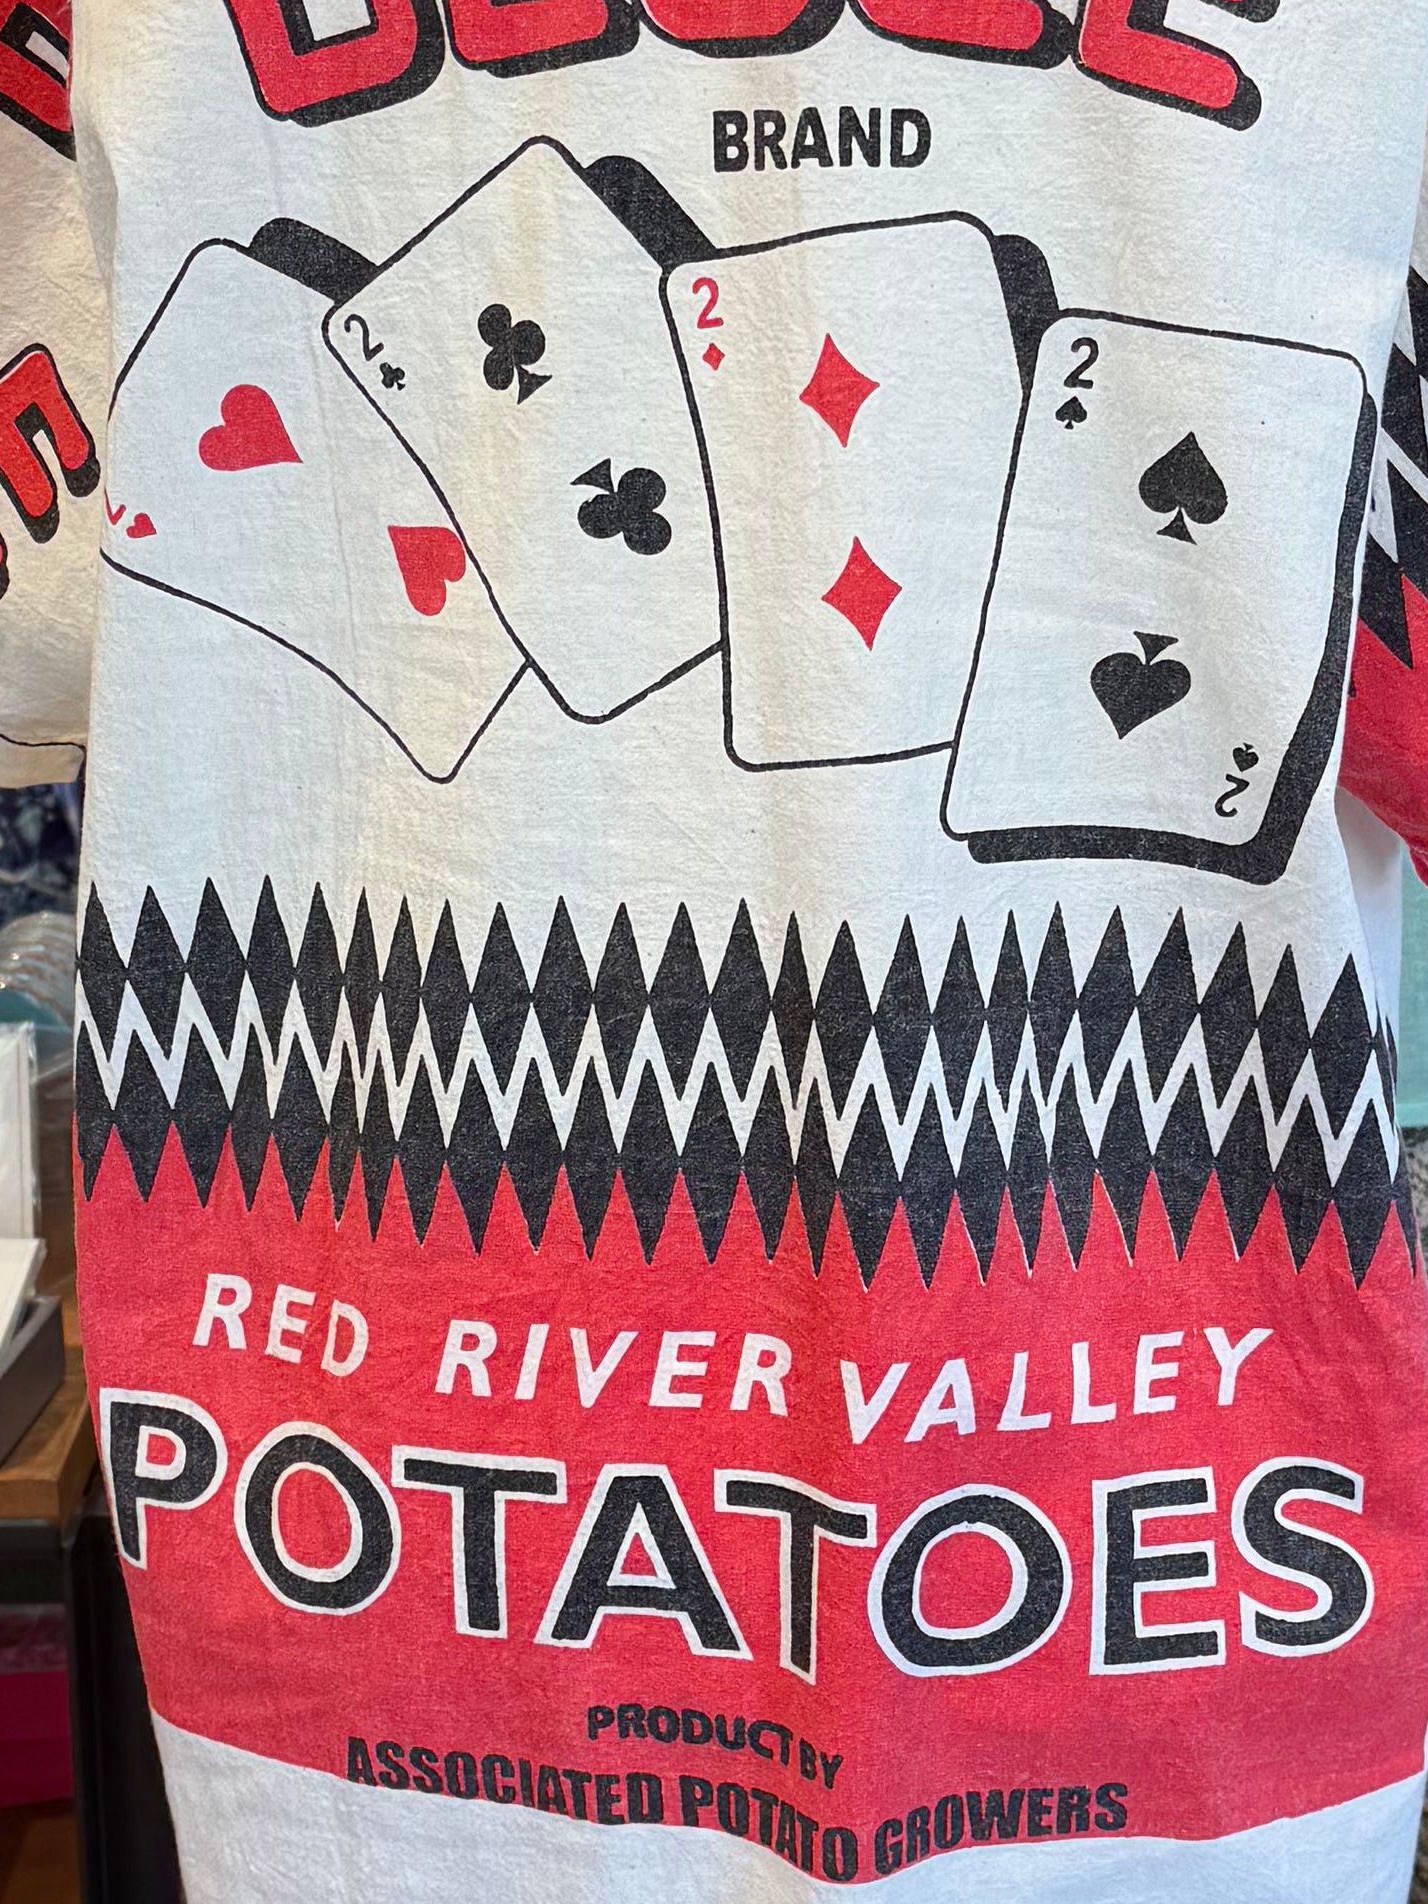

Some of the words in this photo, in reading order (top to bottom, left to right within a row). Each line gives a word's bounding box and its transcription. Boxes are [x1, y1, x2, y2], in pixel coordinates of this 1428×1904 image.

[713, 104, 931, 174] BRAND
[692, 277, 725, 331] 2
[1063, 337, 1101, 390] 2
[192, 1271, 371, 1381] RED
[435, 1318, 795, 1420] RIVER
[837, 1324, 1277, 1449] VALLEY
[95, 1386, 1377, 1687] POTATOES
[586, 1702, 795, 1768] PRODUCT
[798, 1736, 845, 1791] BY
[345, 1734, 665, 1827] ASSOCIATED
[678, 1773, 859, 1883] POTATO
[873, 1780, 1131, 1877] GROWERS
